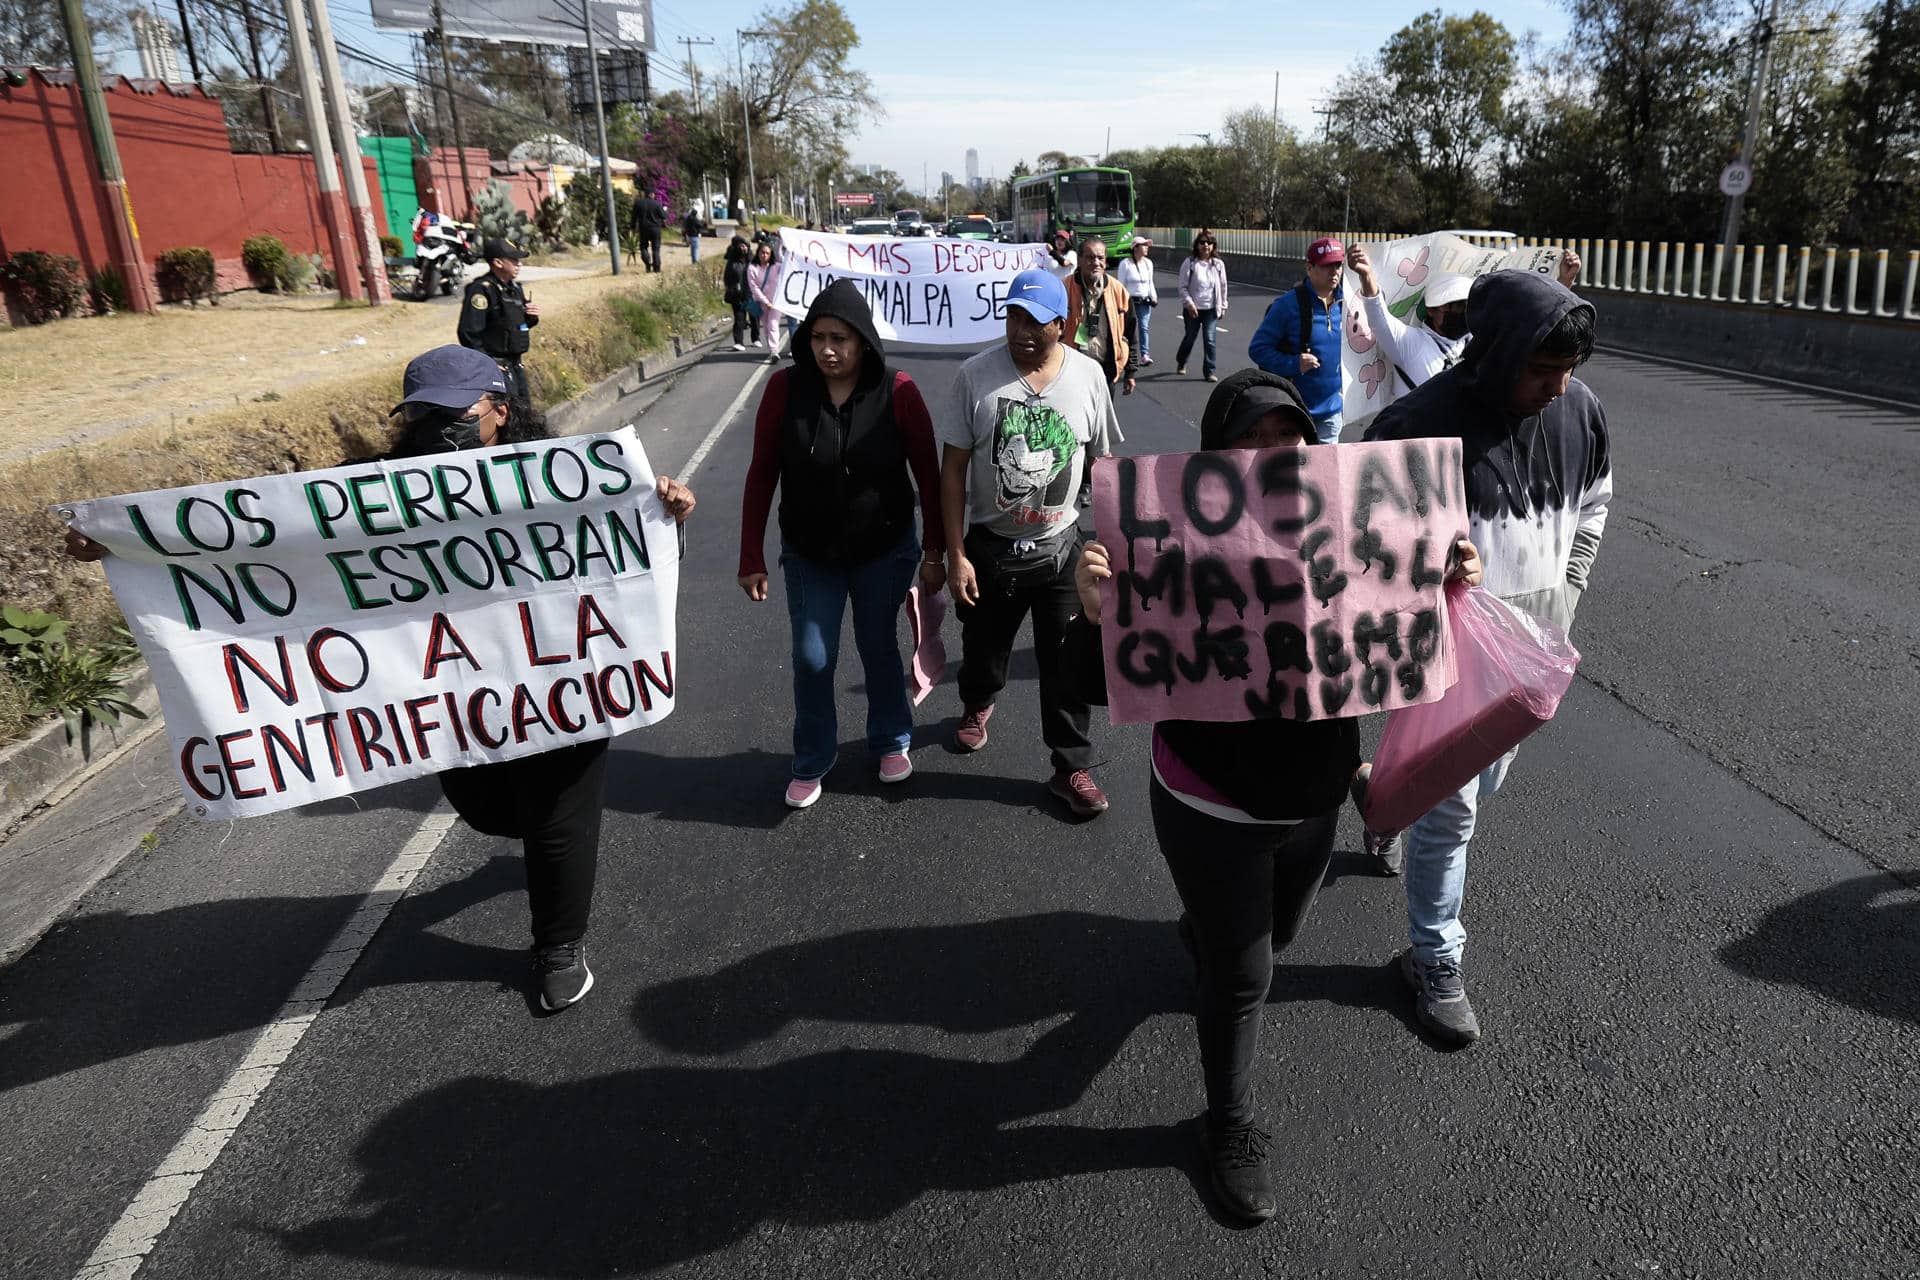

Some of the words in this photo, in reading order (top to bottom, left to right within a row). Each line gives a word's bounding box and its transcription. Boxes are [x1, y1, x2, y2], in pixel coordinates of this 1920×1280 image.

[1728, 170, 1745, 182] 60
[847, 243, 911, 275] MAS
[126, 487, 276, 558] LOS
[304, 438, 633, 540] PERRITOS
[1117, 447, 1325, 540] LOS
[1353, 440, 1464, 530] ANI
[166, 561, 298, 632] NO
[326, 507, 651, 611] ESTORBAN
[222, 626, 370, 713] NO
[423, 611, 482, 680] A
[519, 594, 628, 668] LA
[180, 650, 676, 802] GENTRIFICACION
